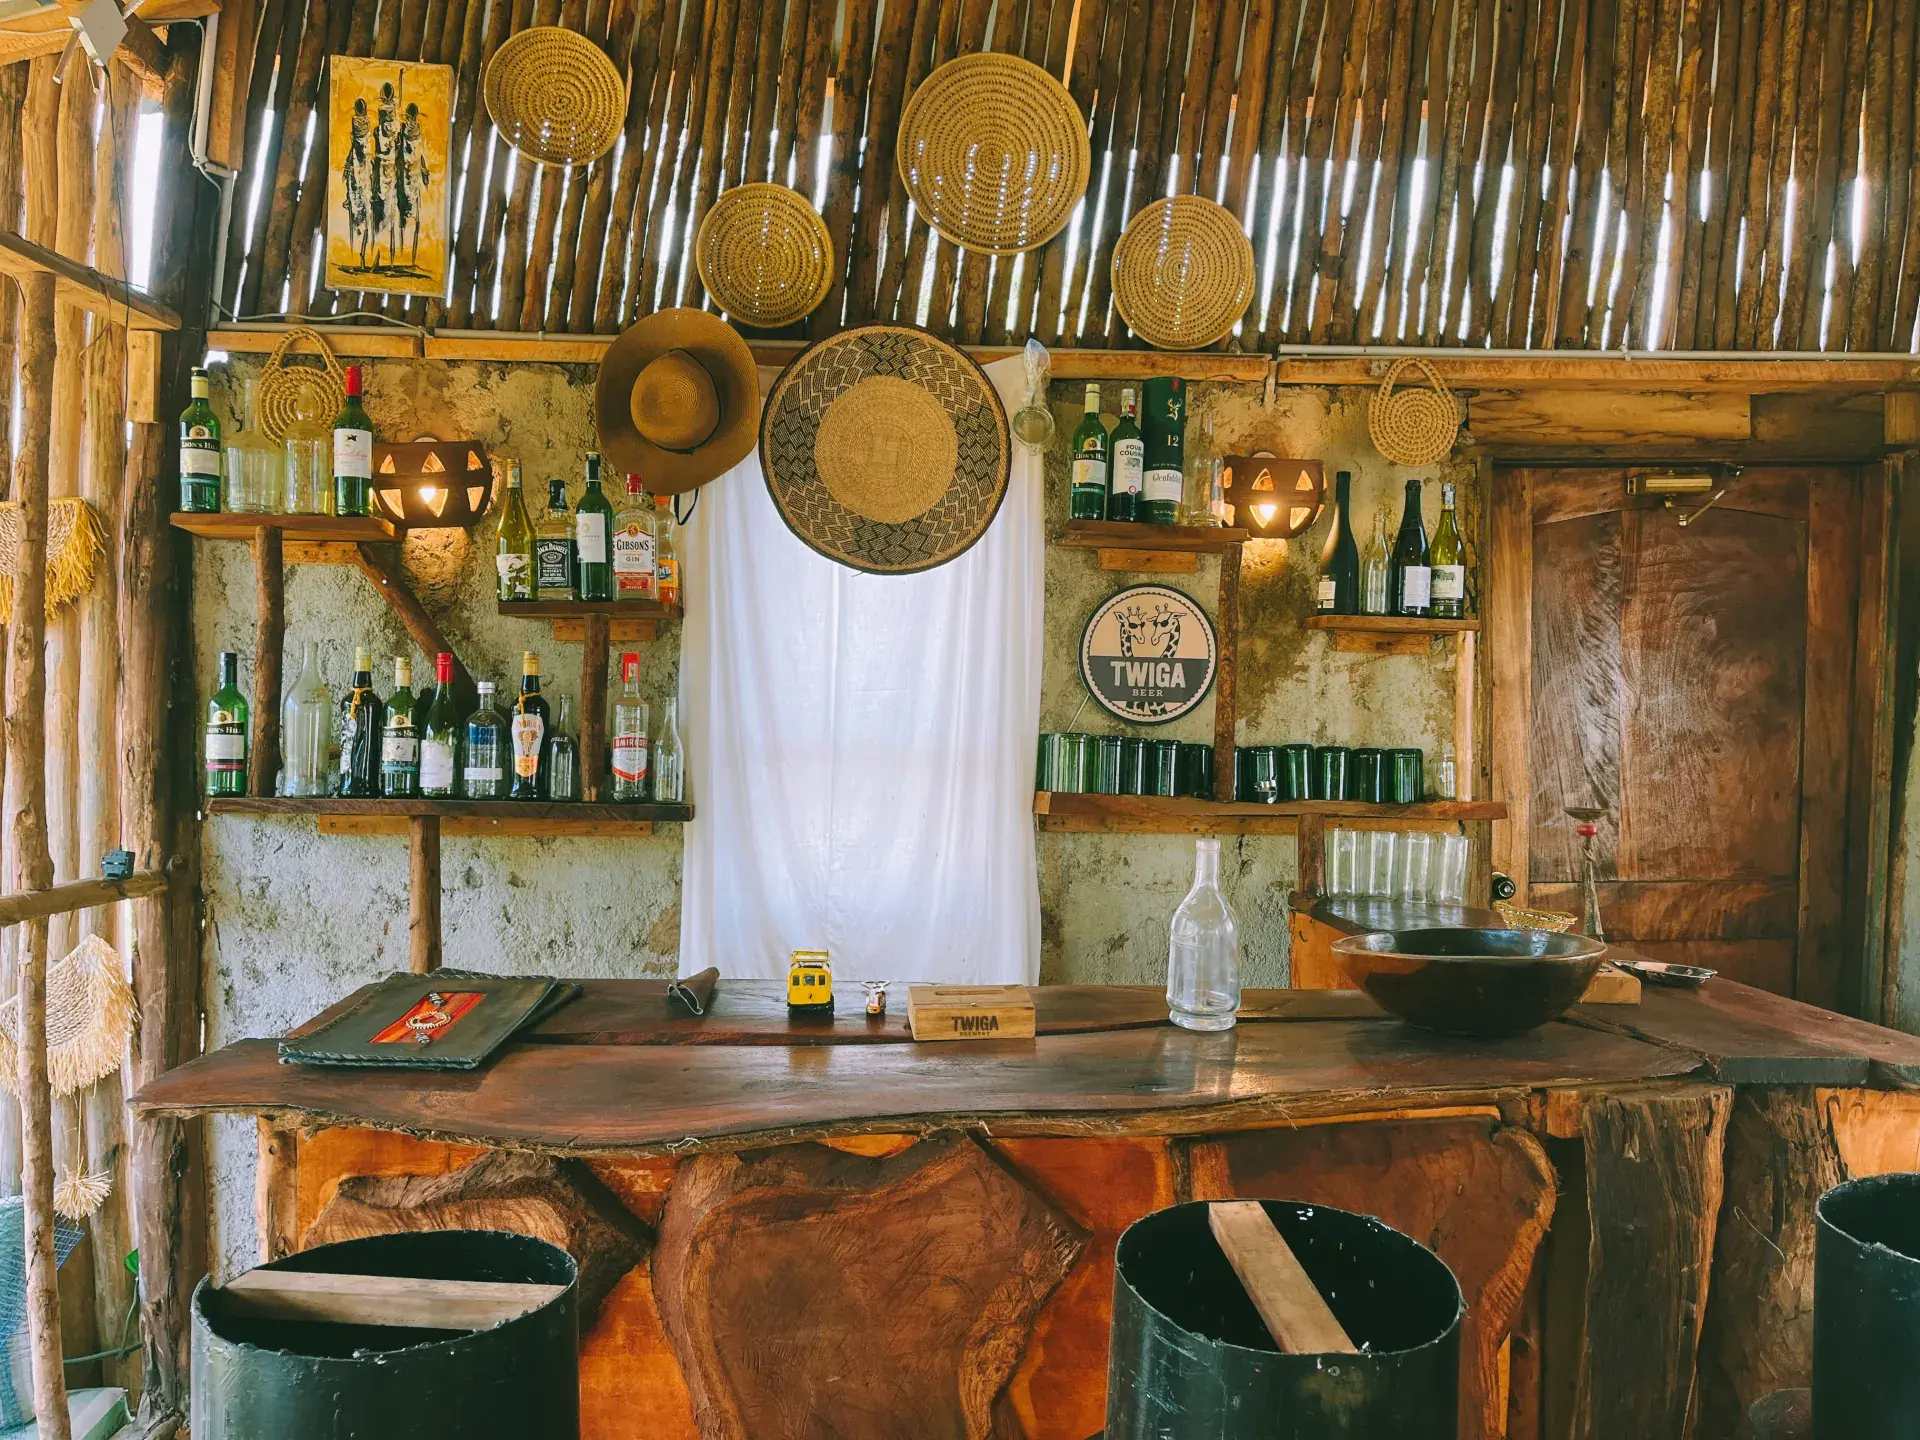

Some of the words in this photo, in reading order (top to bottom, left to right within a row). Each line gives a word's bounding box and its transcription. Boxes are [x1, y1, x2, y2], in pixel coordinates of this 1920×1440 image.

[1167, 434, 1179, 447] 12
[616, 539, 650, 551] GIBSON'S
[1110, 661, 1186, 689] TWIGA
[1132, 688, 1163, 697] BEER
[951, 1015, 999, 1031] TWIGA
